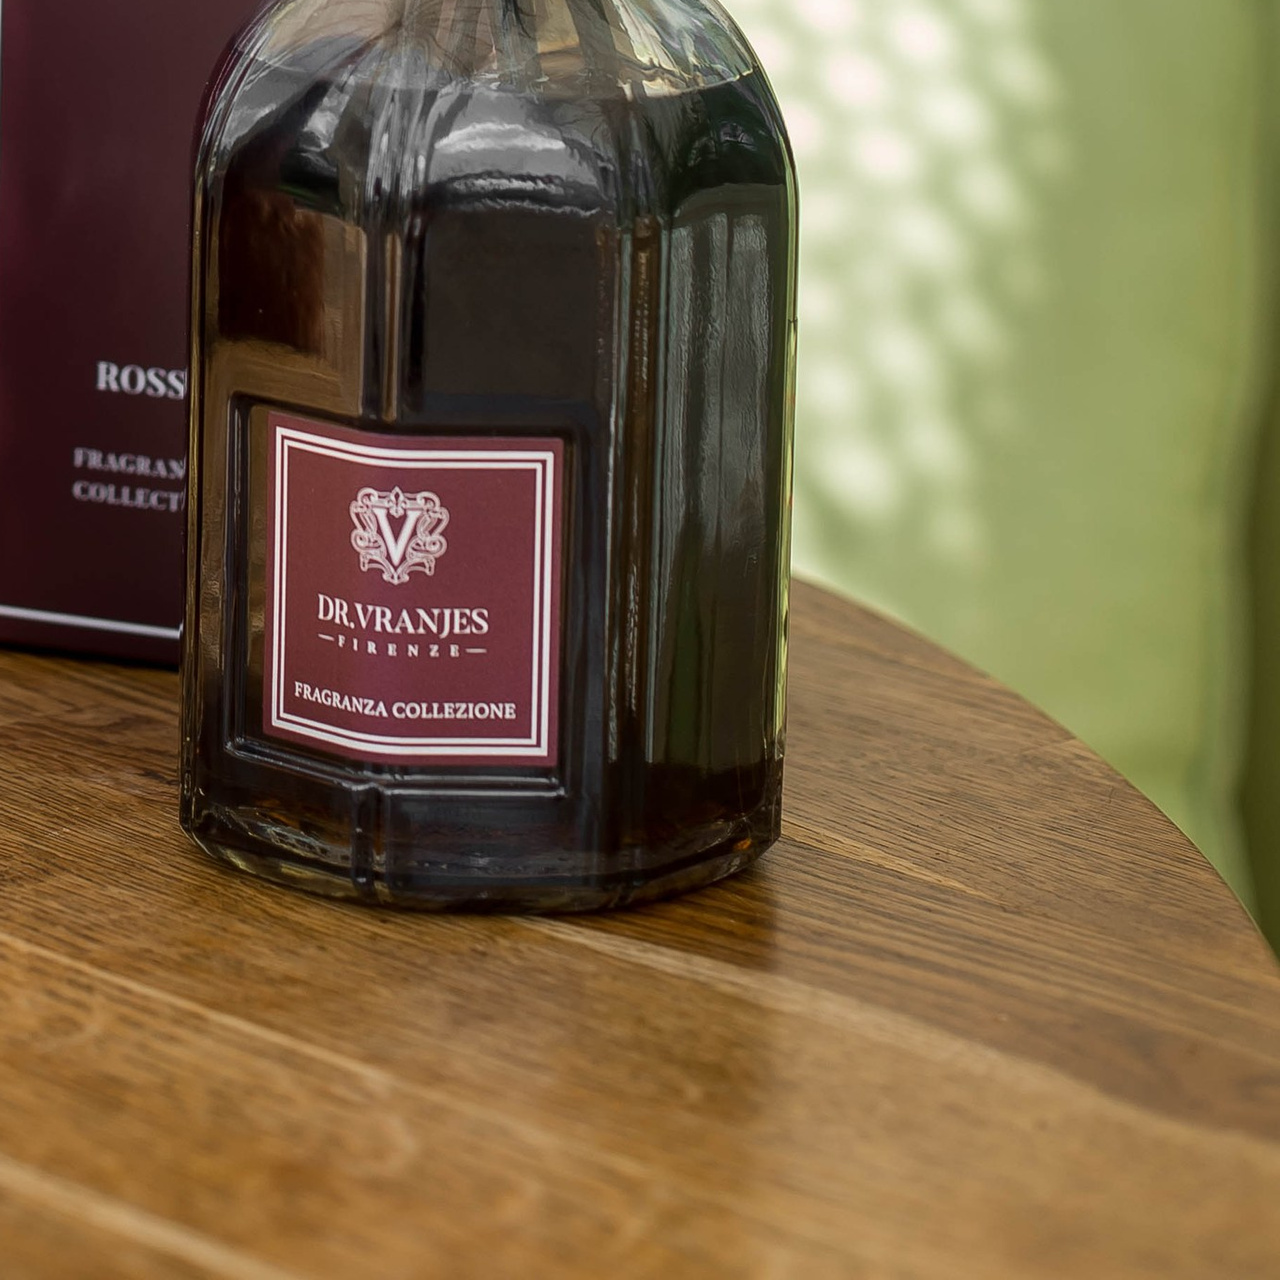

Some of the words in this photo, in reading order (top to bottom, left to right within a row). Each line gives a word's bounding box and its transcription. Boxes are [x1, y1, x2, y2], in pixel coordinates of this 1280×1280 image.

[96, 361, 187, 400] ROSS
[73, 446, 186, 480] FRAGRAN
[72, 480, 185, 512] COLLECT
[317, 593, 490, 639] DR.VRANJES
[337, 634, 460, 658] FIRENZE
[294, 681, 389, 717] FRAGRANZA
[391, 701, 517, 720] COLLEZIONE
